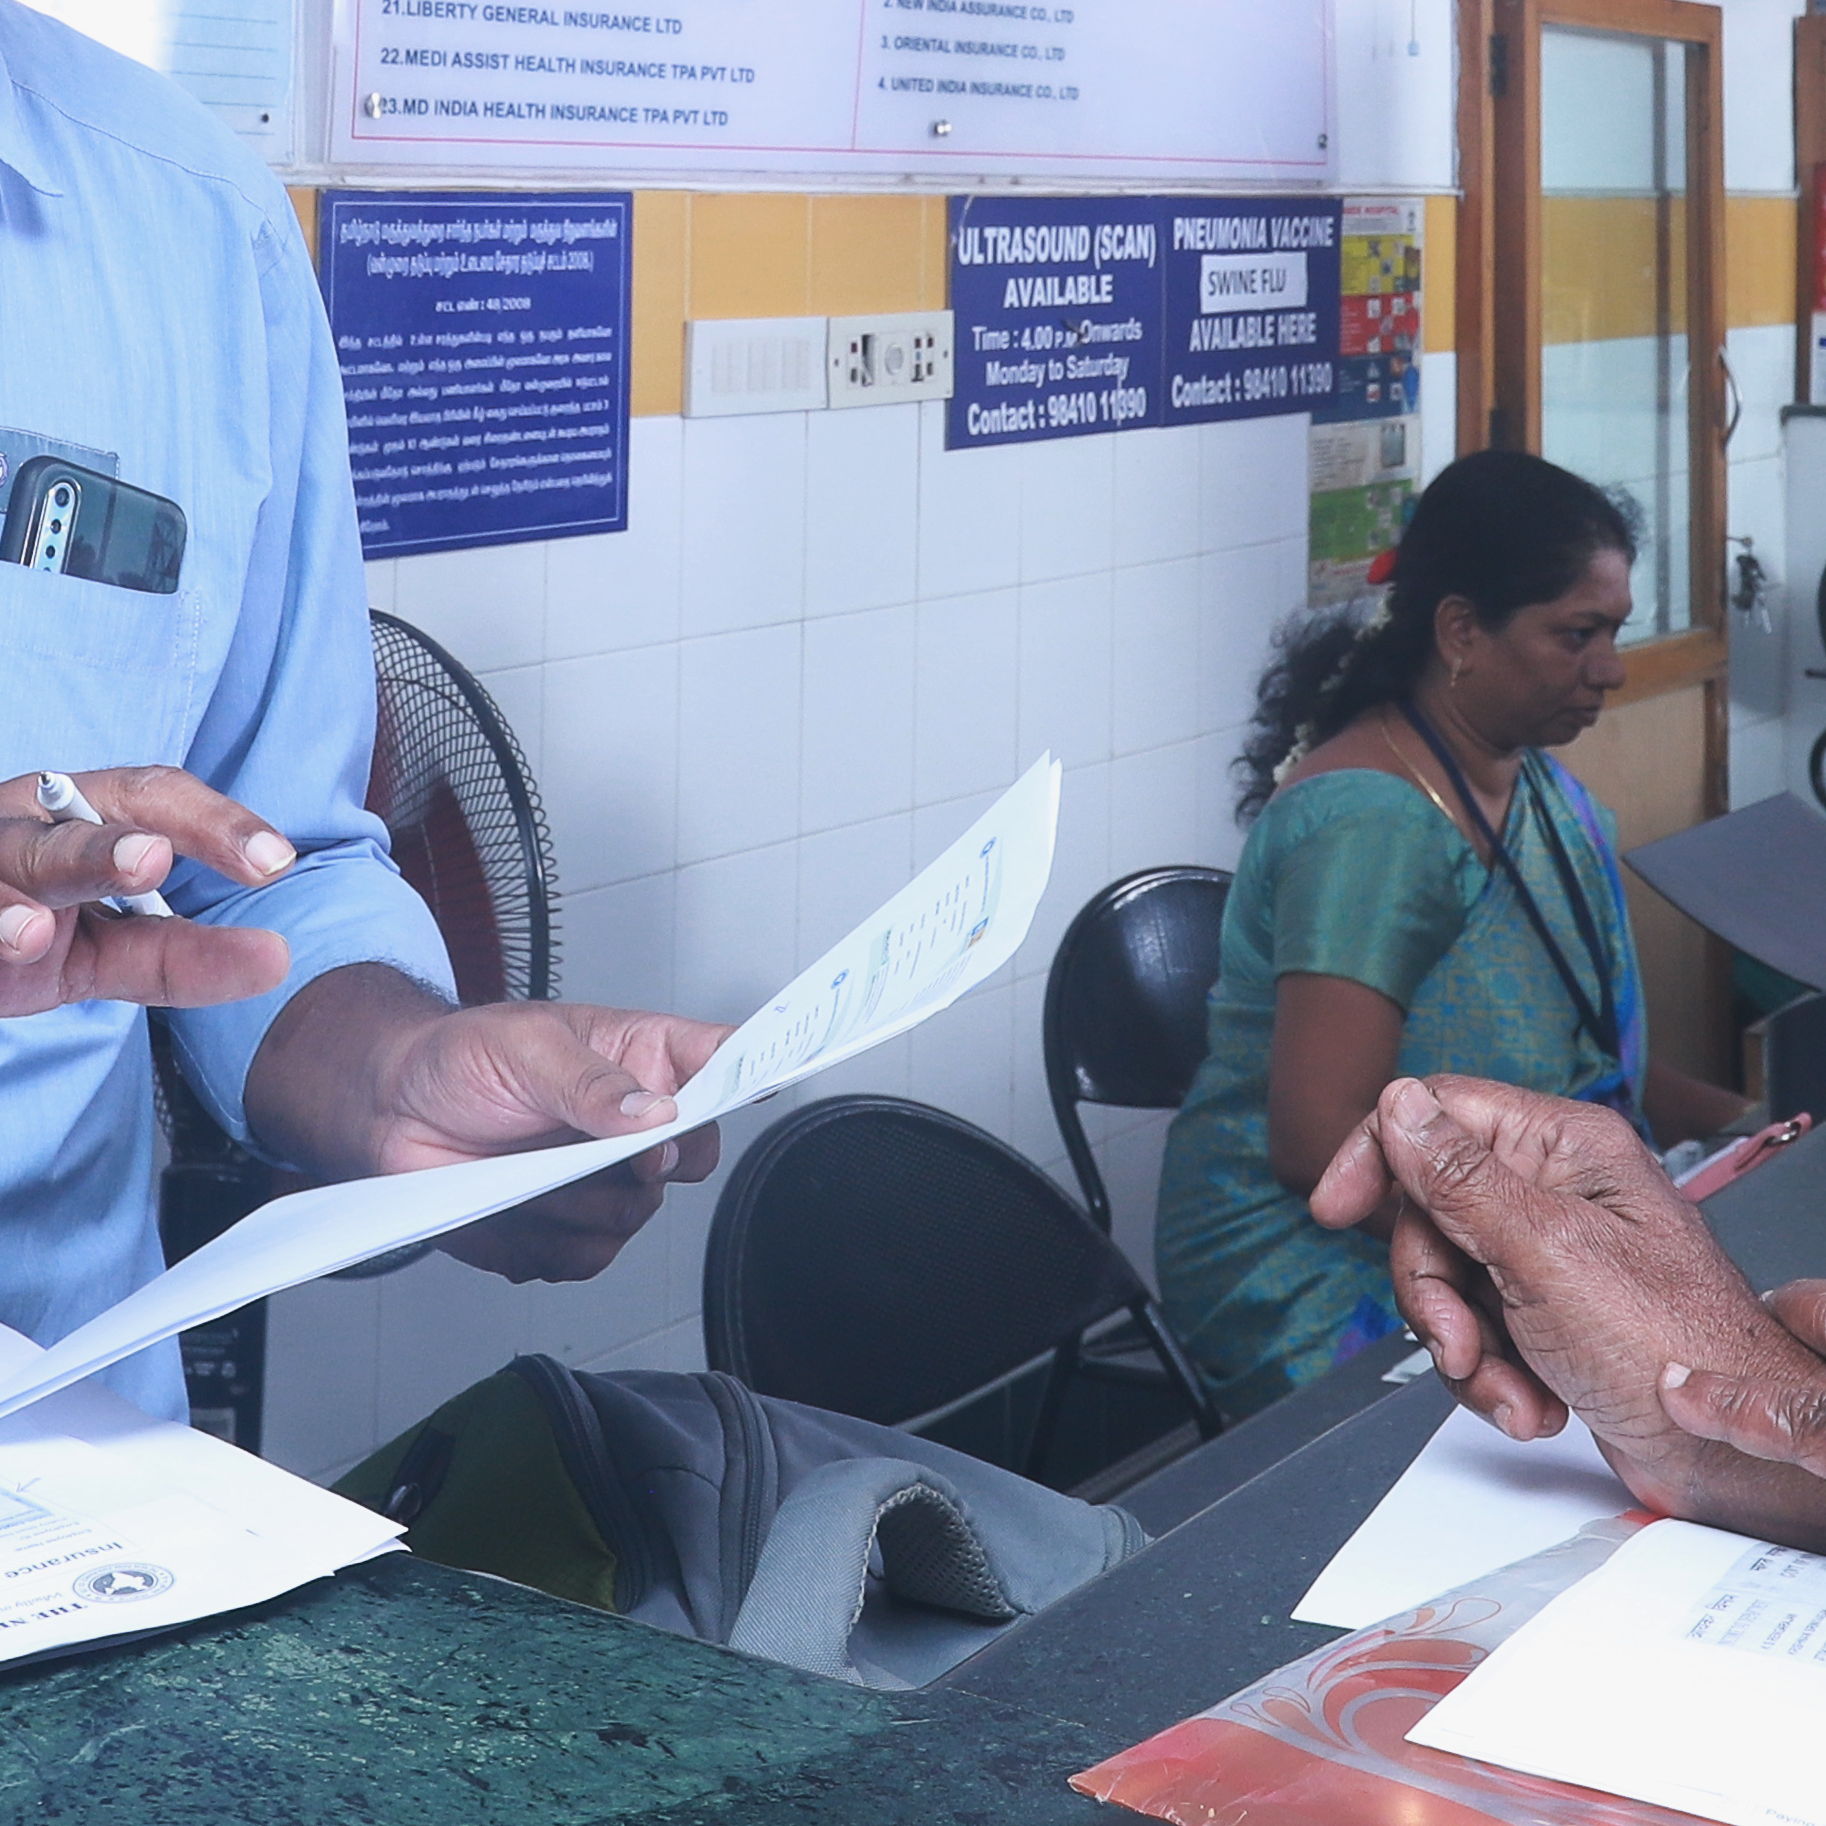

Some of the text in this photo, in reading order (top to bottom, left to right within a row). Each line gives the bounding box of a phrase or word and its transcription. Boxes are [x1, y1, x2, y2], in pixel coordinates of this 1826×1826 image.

[958, 223, 1157, 268] ULTRASOUND (SCAN)
[1173, 216, 1334, 250] PNEUMONIA VACCINE
[1003, 274, 1114, 307] AVAILABLE
[1207, 268, 1288, 296] SWINE FLU
[971, 325, 1011, 350] Time
[1020, 324, 1054, 350] 4.00
[1079, 317, 1144, 344] Onwards
[1188, 312, 1317, 351] AVAILABLE HERE
[985, 352, 1130, 387] Monday to Saturday
[1171, 372, 1233, 407] Contact
[1242, 366, 1288, 400] 98410
[1290, 362, 1333, 394] 11390
[967, 399, 1037, 435] Contact
[1047, 392, 1097, 426] 98410
[4, 1541, 124, 1580] Insurance
